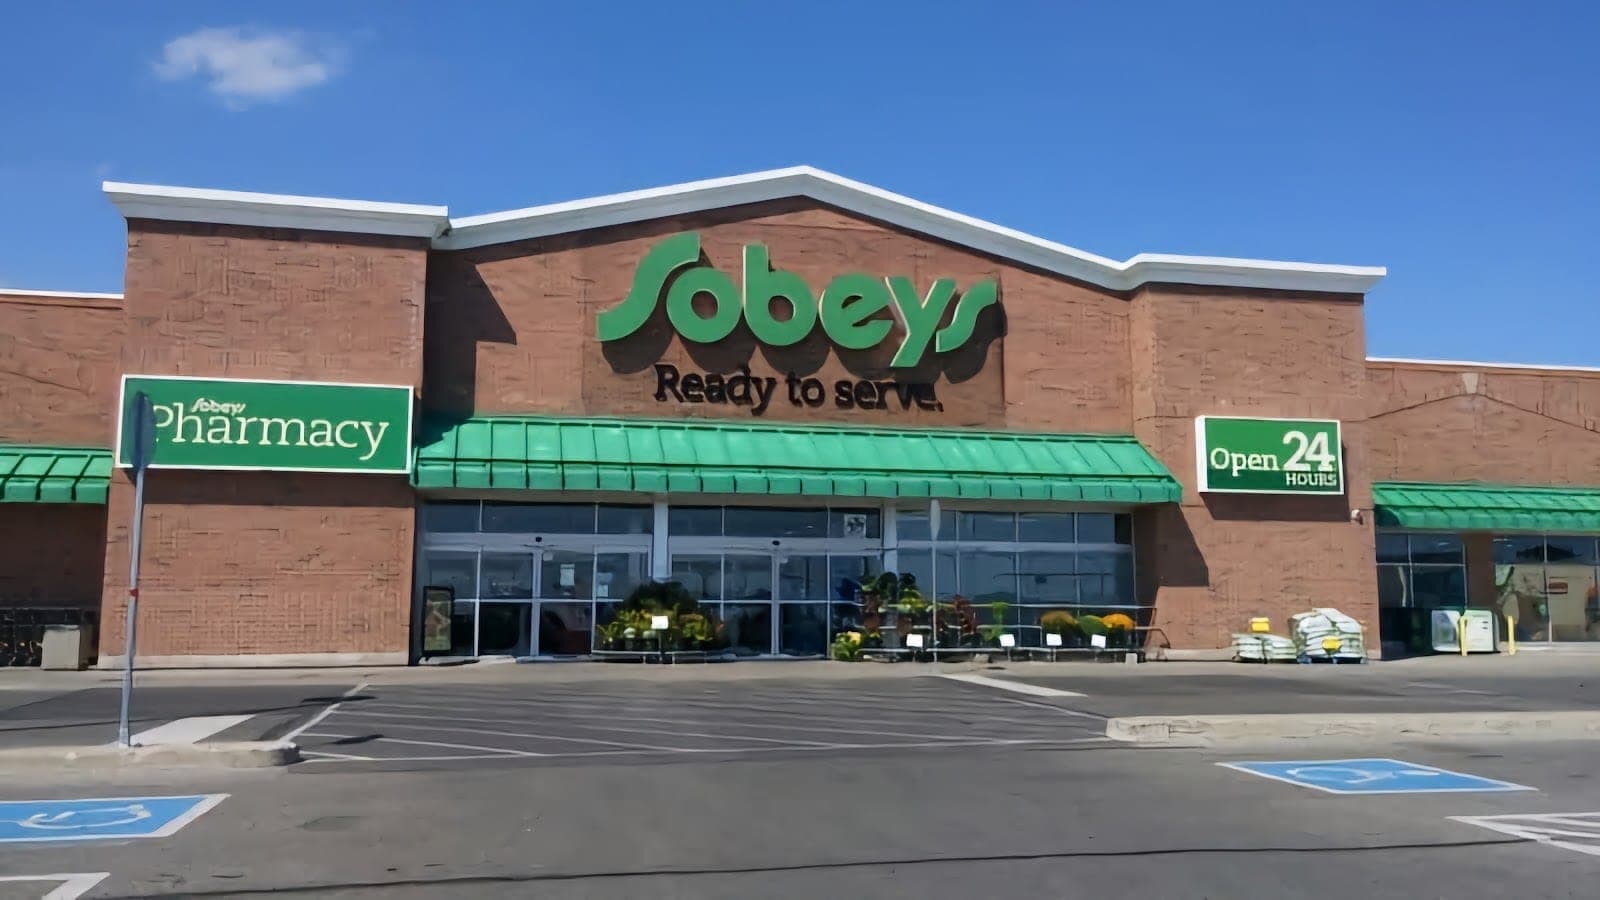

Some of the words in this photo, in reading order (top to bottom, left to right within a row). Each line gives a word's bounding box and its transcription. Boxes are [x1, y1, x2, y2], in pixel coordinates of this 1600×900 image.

[596, 231, 998, 367] Sobeys
[655, 363, 777, 416] Ready
[785, 378, 826, 407] to
[1210, 447, 1280, 477] Open
[1282, 430, 1336, 472] 24
[1285, 472, 1337, 486] HOURS
